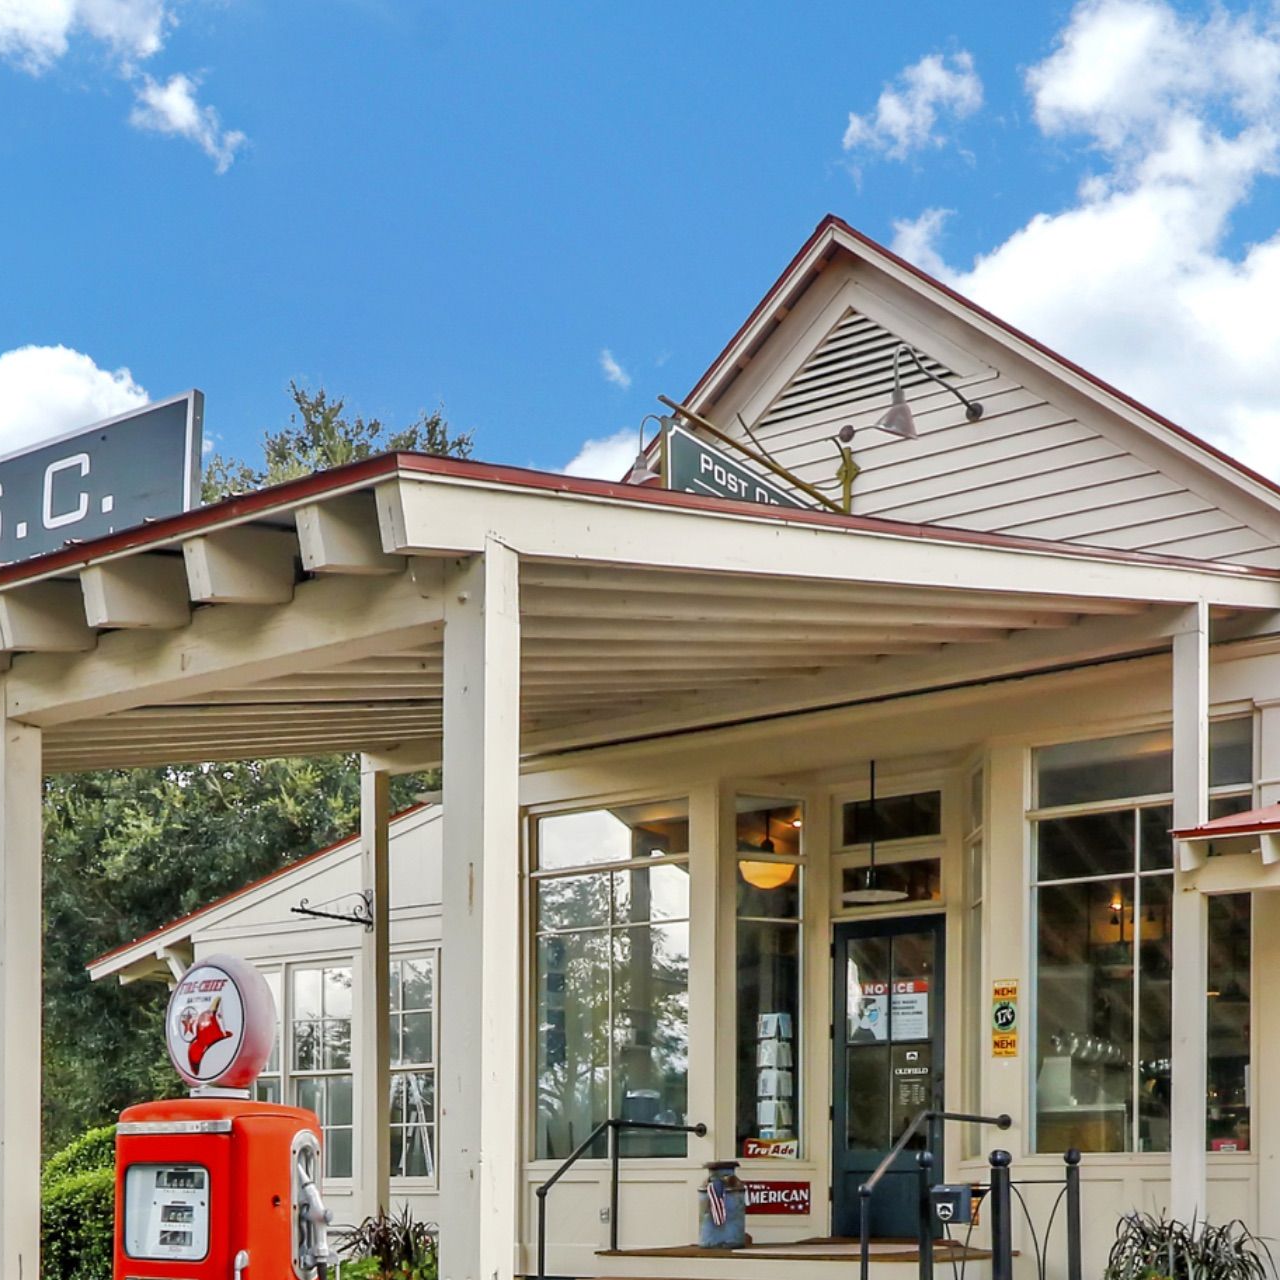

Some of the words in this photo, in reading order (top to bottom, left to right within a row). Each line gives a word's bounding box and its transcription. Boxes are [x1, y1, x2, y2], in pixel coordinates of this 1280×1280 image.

[701, 453, 749, 498] POST
[995, 988, 1017, 996] NEHI
[994, 1040, 1016, 1048] NEHI
